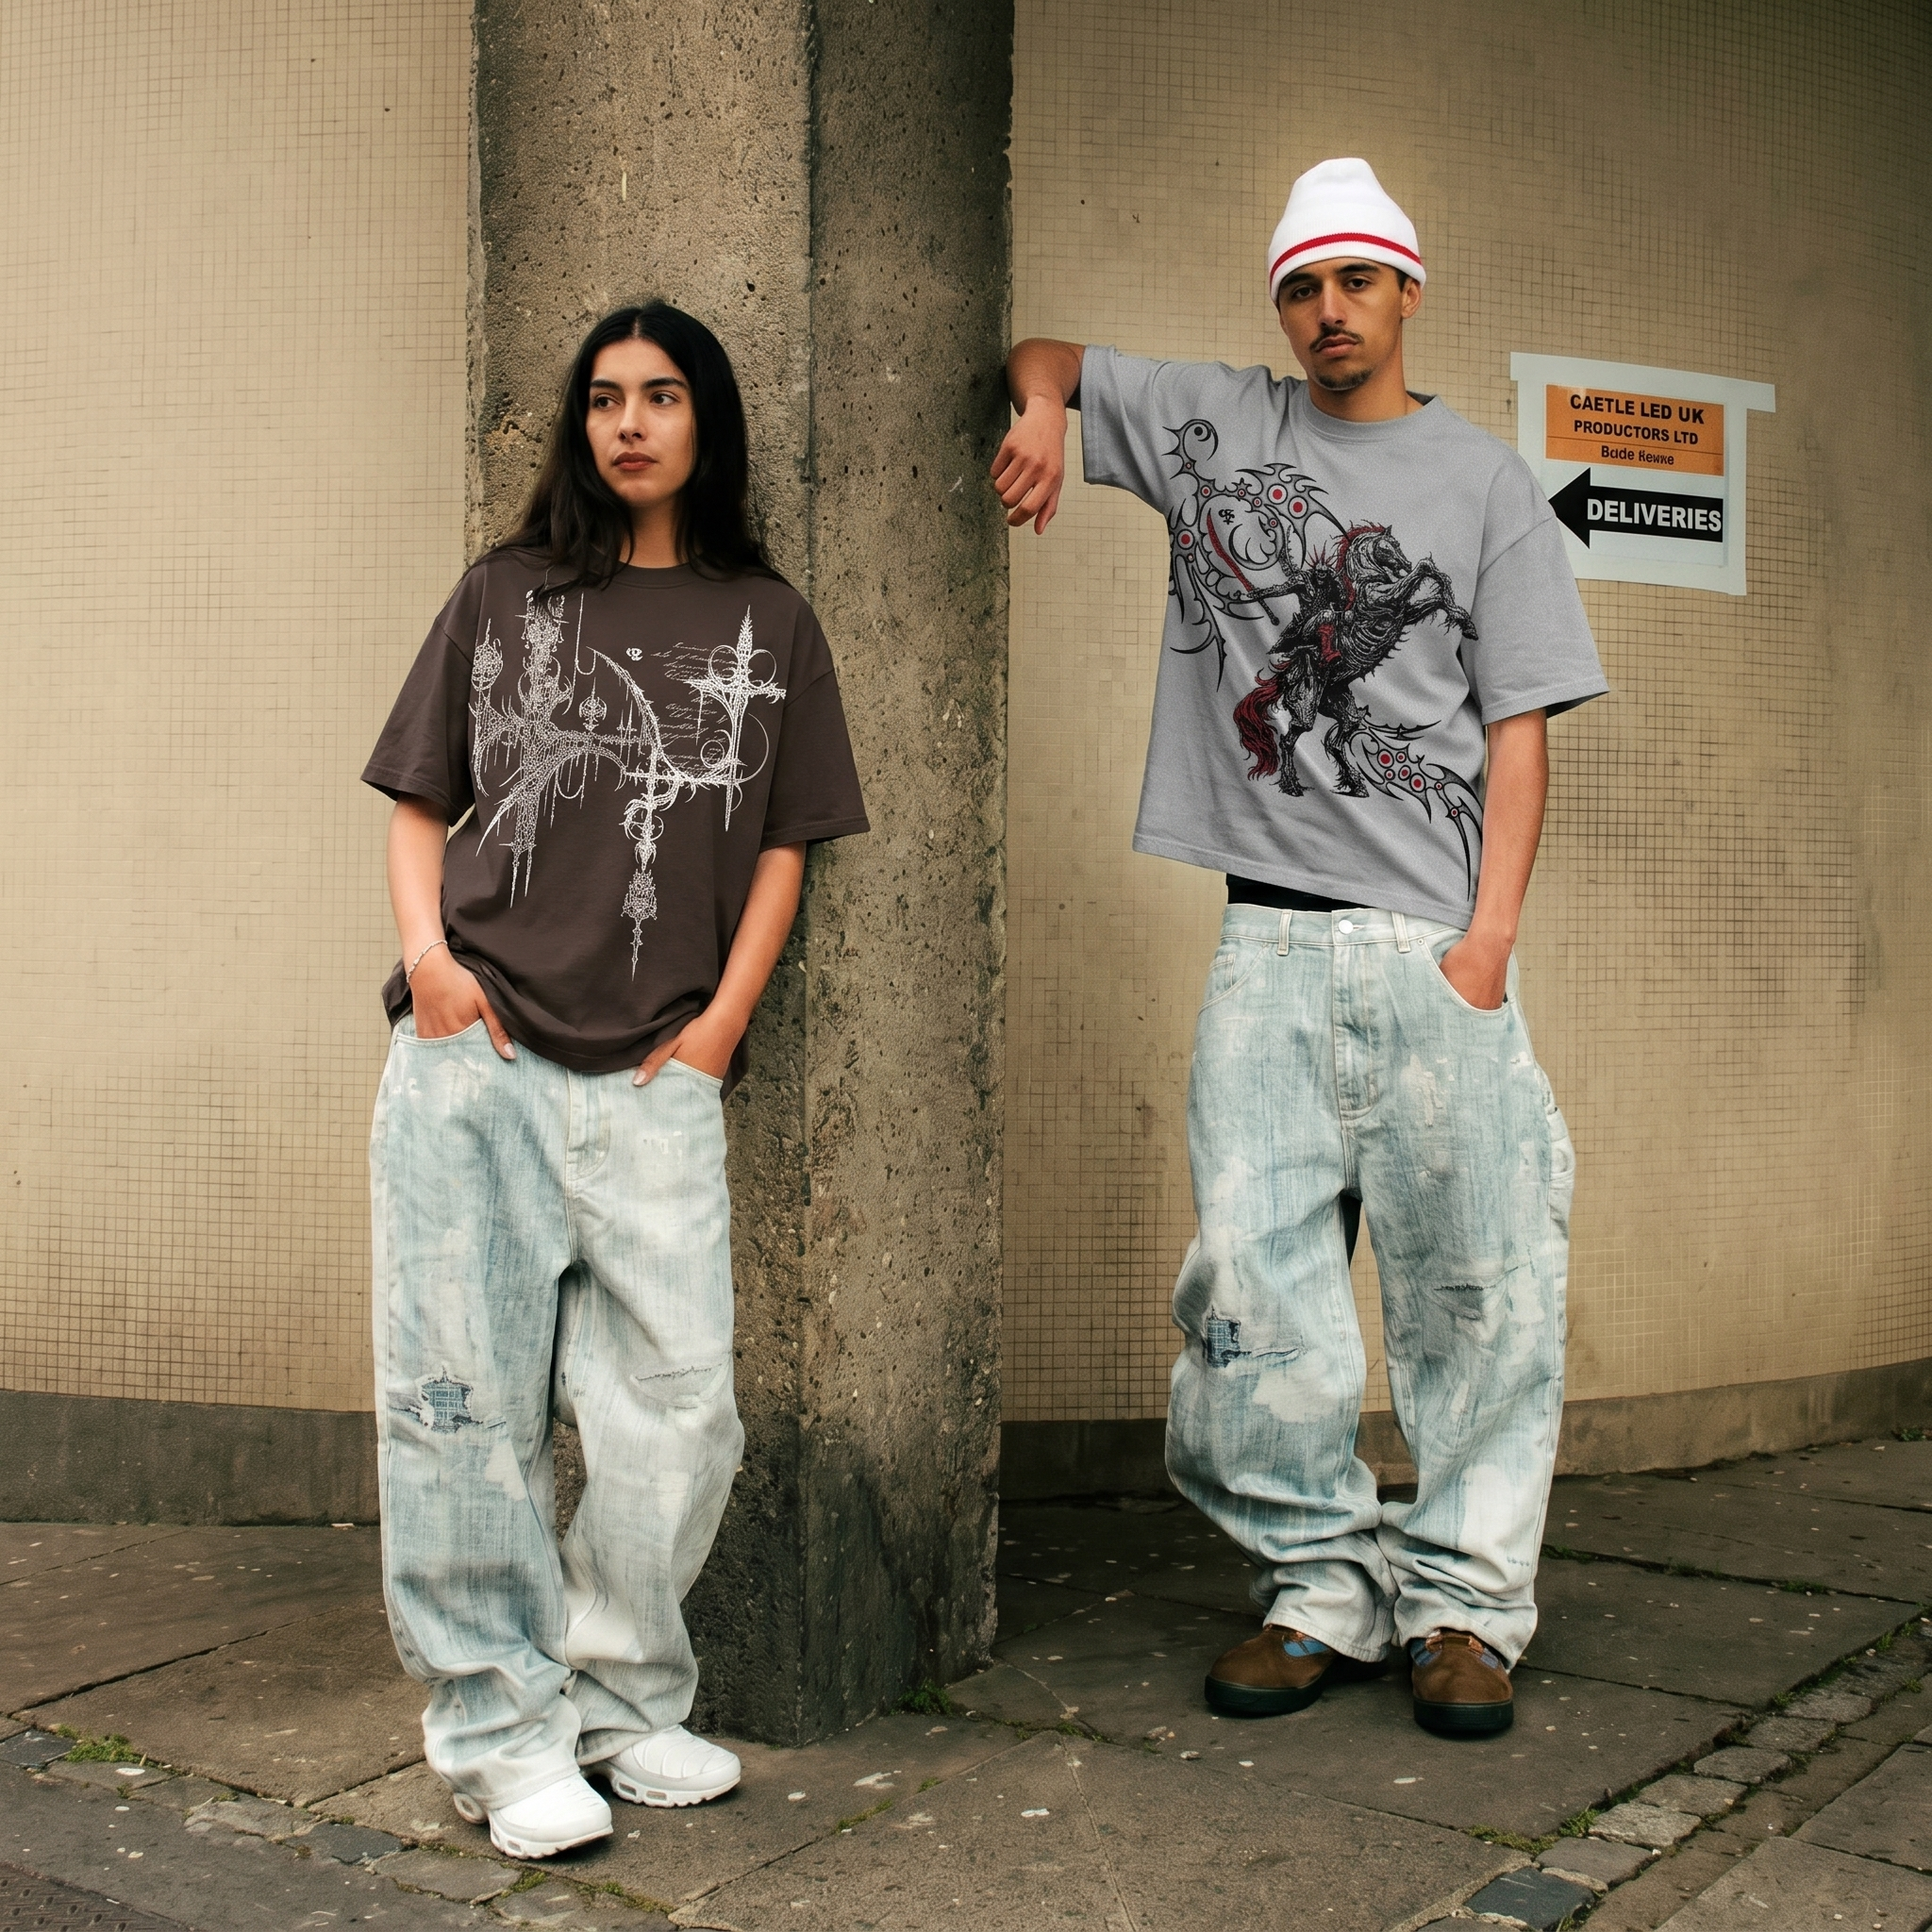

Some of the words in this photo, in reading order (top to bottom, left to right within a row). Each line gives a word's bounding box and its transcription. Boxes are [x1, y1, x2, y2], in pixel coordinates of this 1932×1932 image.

[1570, 394, 1635, 416] CAETLE
[1641, 402, 1673, 420] LED
[1678, 406, 1705, 425] UK
[1574, 420, 1670, 441] PRODUCTORS
[1674, 430, 1699, 445] LTD
[1587, 498, 1723, 532] DELIVERIES
